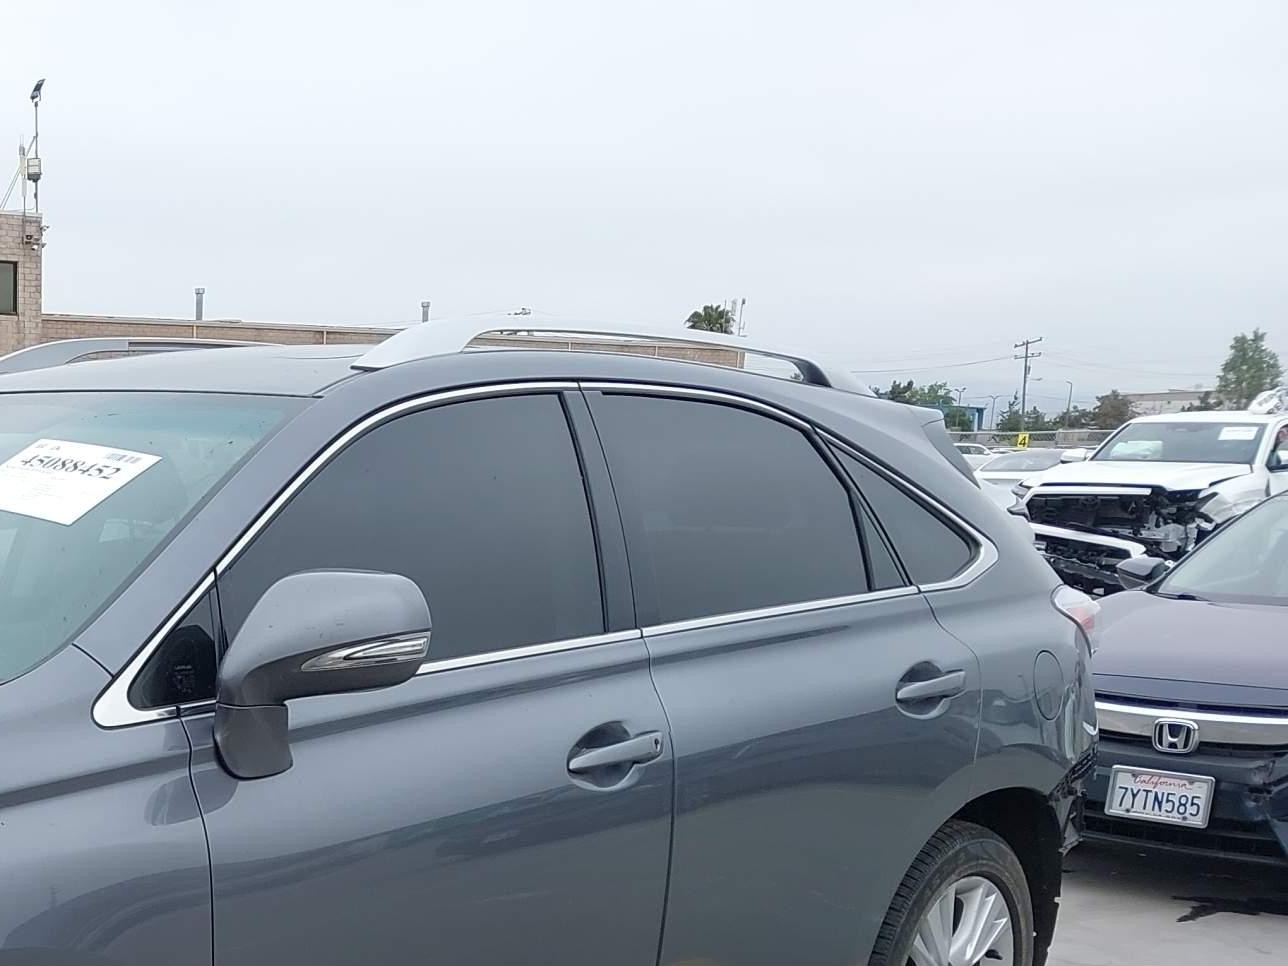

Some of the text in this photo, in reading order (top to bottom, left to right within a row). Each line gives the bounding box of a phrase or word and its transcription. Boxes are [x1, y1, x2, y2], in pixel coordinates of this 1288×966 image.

[1018, 435, 1027, 448] 4
[21, 454, 121, 480] 45088452
[1133, 774, 1193, 791] California
[1118, 786, 1202, 817] 7YTN585
